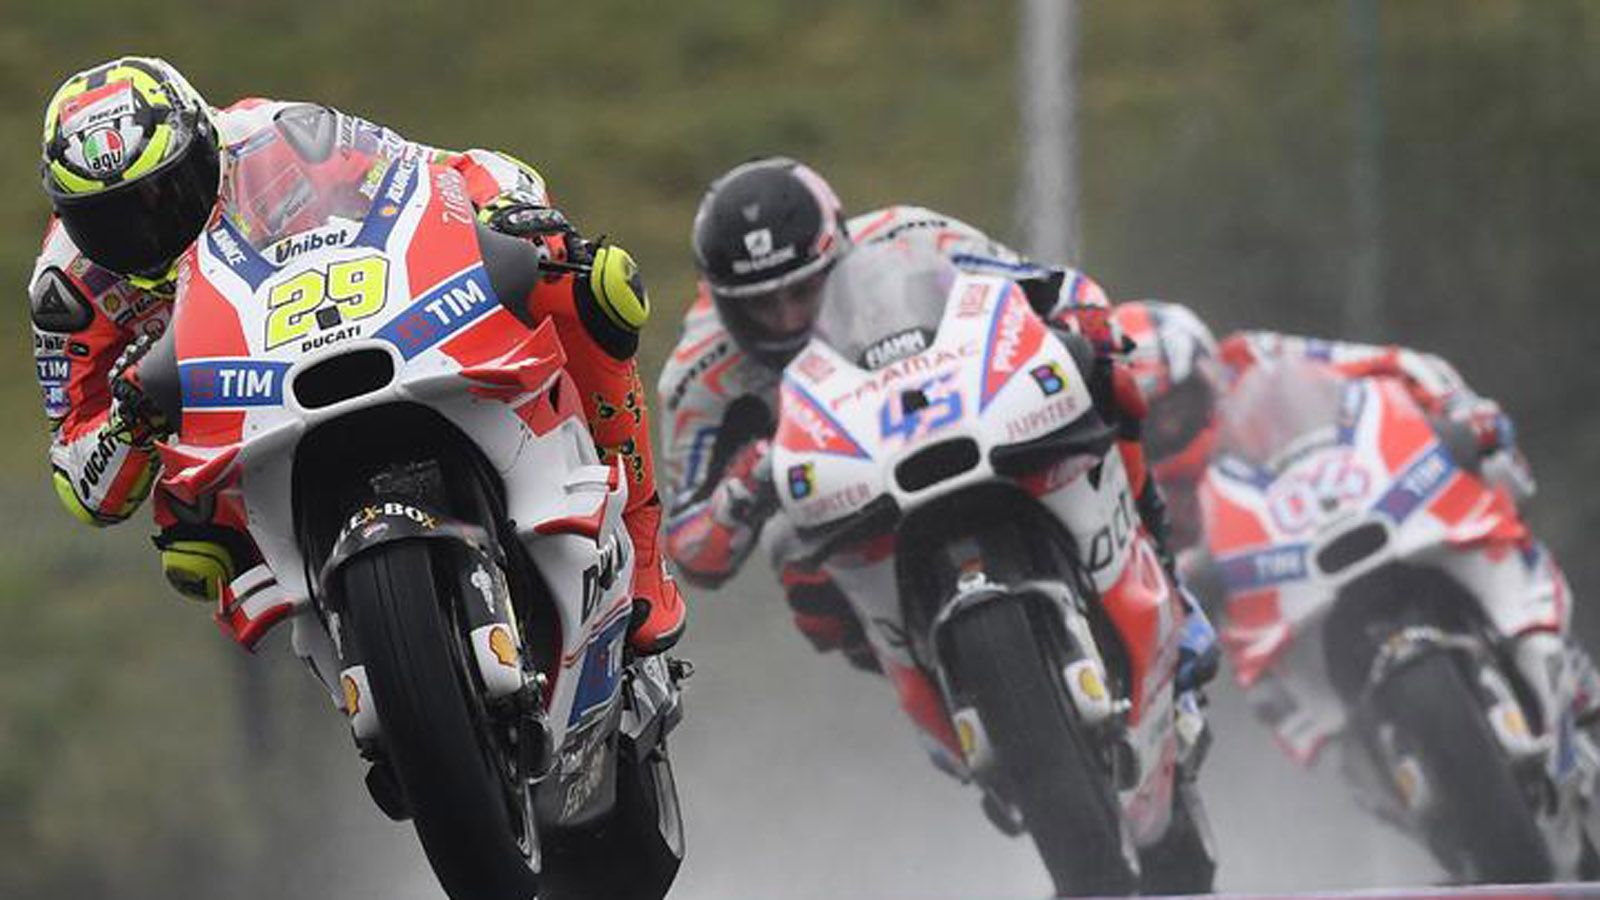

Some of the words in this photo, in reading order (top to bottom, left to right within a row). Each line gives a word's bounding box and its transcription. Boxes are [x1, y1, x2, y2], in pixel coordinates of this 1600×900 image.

[275, 229, 348, 263] Unibat
[265, 255, 390, 352] 29
[425, 278, 487, 325] TIM
[301, 326, 362, 353] DUCATI
[37, 360, 68, 378] TIM
[220, 368, 274, 397] TIM
